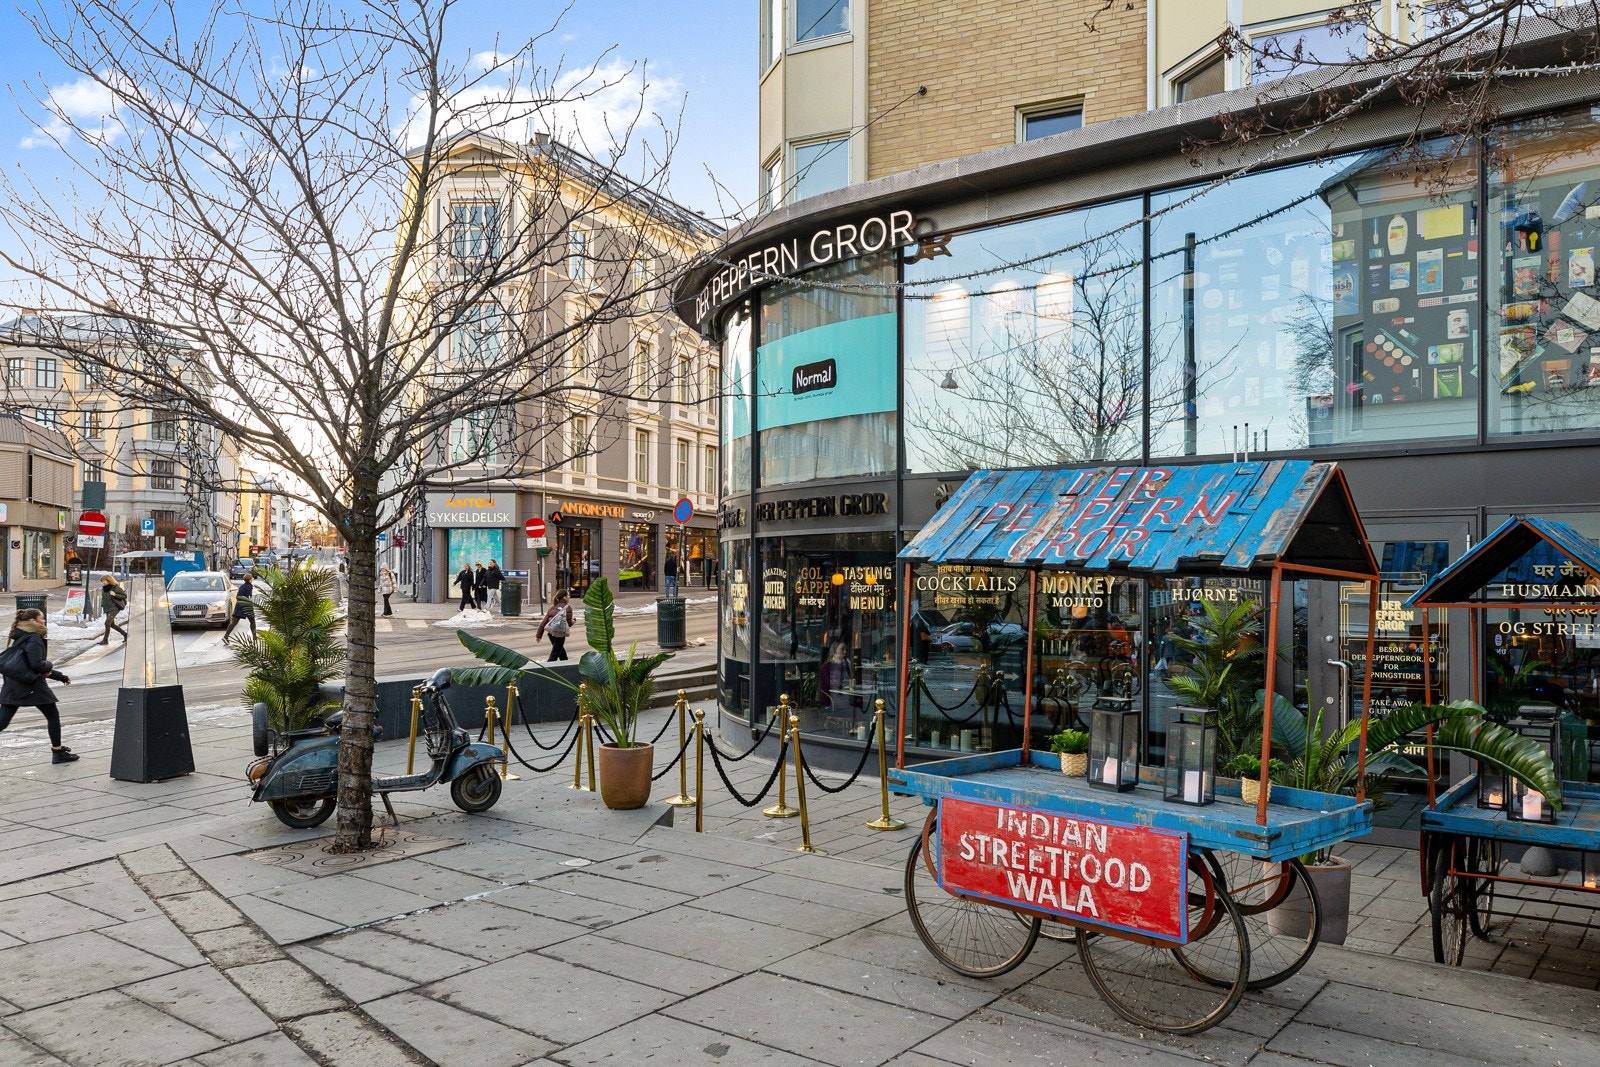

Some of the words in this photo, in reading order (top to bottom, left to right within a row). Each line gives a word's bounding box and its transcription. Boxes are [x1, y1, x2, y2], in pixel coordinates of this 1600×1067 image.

[695, 286, 709, 324] DER
[712, 238, 798, 306] PEPPERN
[810, 210, 914, 263] GROR
[796, 365, 831, 388] Normal
[1068, 469, 1174, 501] DER
[445, 497, 495, 508] ANTON
[840, 492, 888, 516] GROR
[429, 512, 510, 523] SYKKELDELISK
[1008, 527, 1150, 559] GROR
[801, 566, 823, 580] GOL
[843, 566, 892, 580] TASTING
[764, 581, 784, 594] BUTTER
[795, 581, 830, 594] GAPPE
[916, 576, 1017, 591] COCKTAILS
[1042, 576, 1115, 594] MONKEY
[1171, 588, 1238, 601] HJØRNE
[763, 596, 785, 610] CHICKEN
[850, 596, 884, 610] MENU
[1052, 597, 1103, 608] MOJITO
[1381, 600, 1402, 610] DER
[1375, 610, 1415, 621] EPPERN
[1377, 620, 1406, 631] GROR
[1499, 621, 1526, 634] OG
[1370, 671, 1421, 680] PNINGSTIDER
[997, 808, 1107, 853] INDIAN
[959, 831, 1152, 893] STREETFOOD
[1005, 870, 1099, 918] WALA
